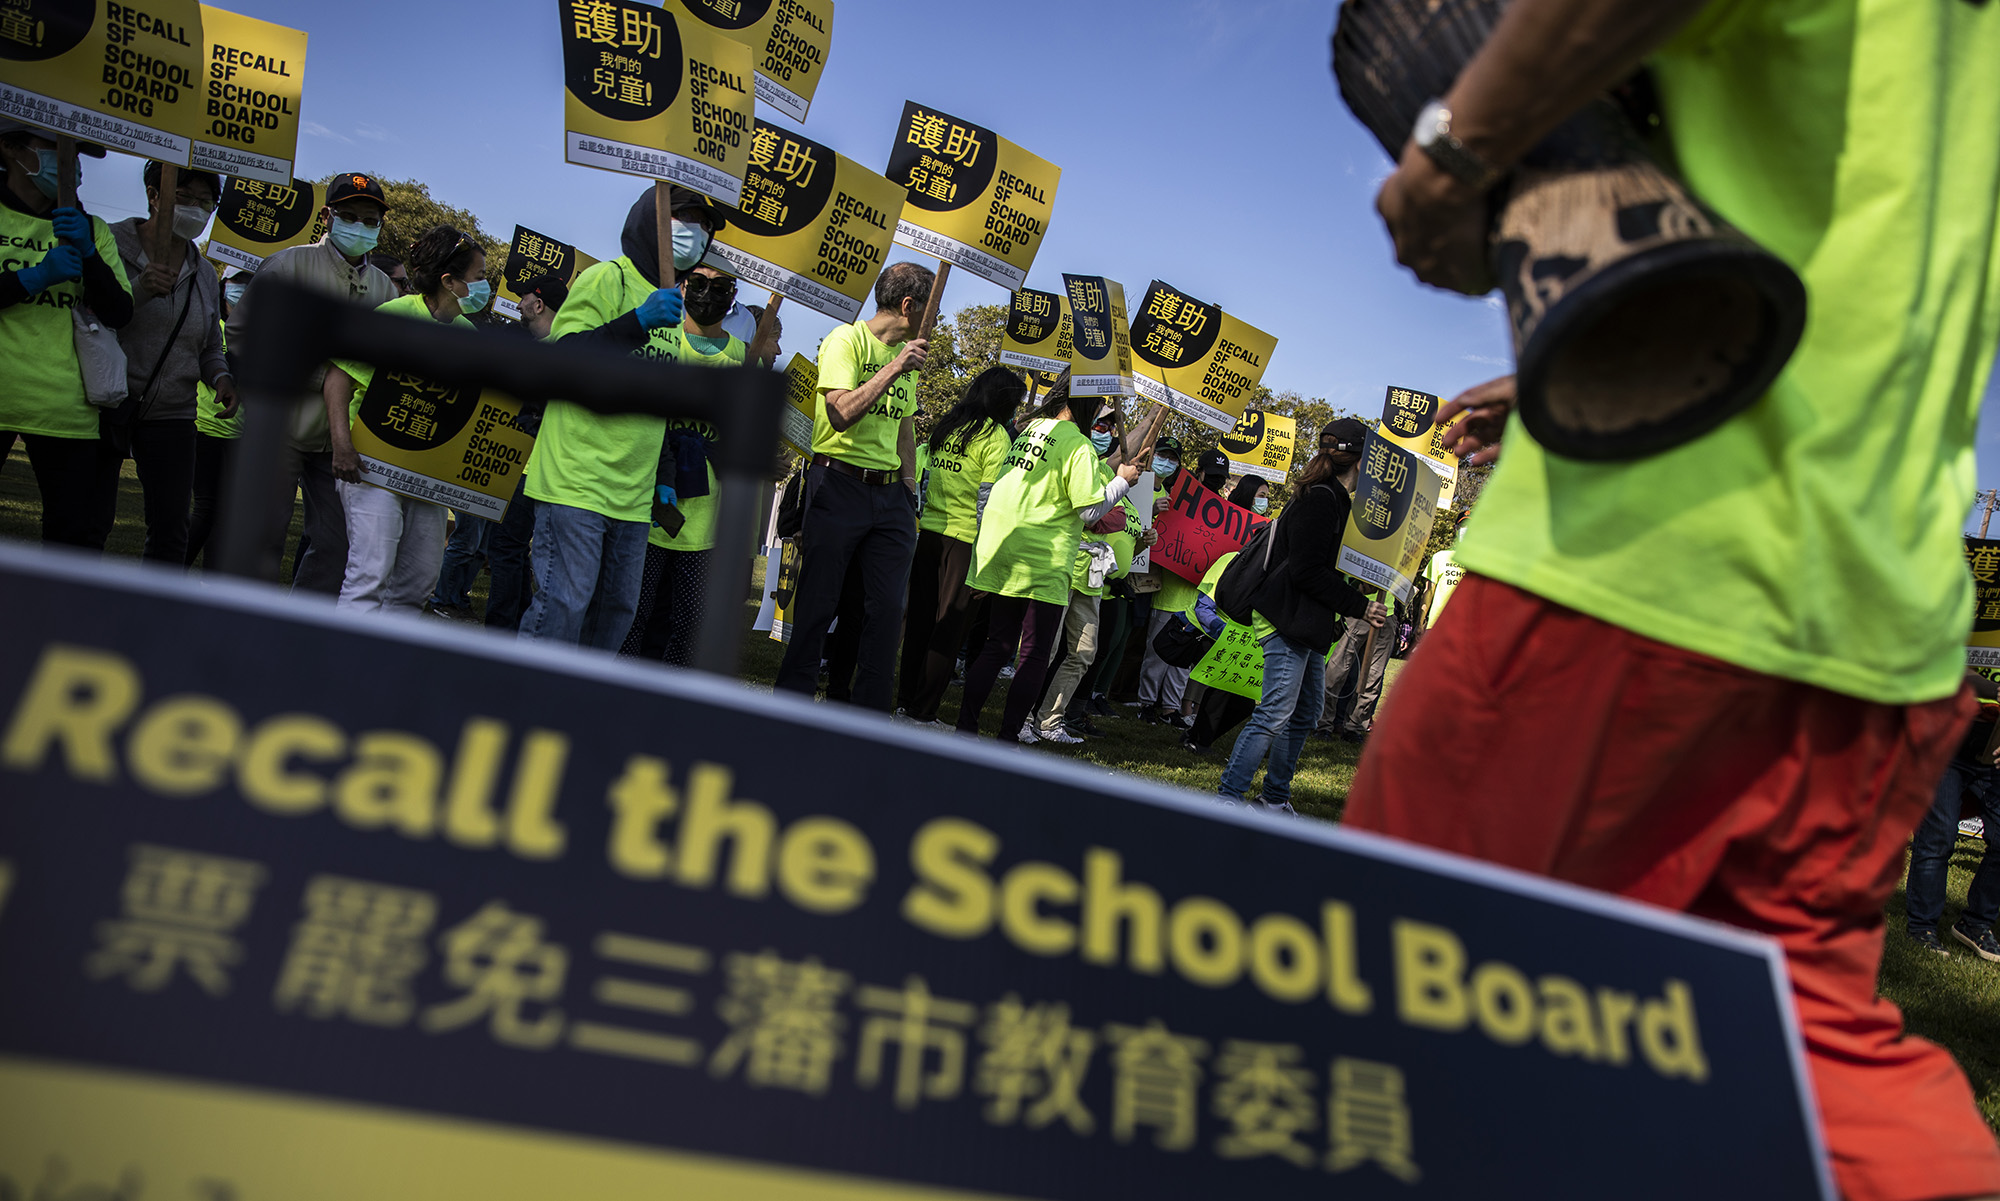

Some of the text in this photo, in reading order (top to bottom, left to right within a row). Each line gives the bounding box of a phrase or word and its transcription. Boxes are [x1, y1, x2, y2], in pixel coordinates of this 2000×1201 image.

[107, 1, 191, 47] RECALL
[573, 0, 662, 59] 護助
[776, 9, 793, 27] SF
[107, 22, 136, 46] SF
[771, 25, 822, 65] SCHOOL
[105, 44, 194, 89] SCHOOL
[210, 62, 237, 81] SF
[212, 44, 291, 77] RECALL
[600, 51, 642, 74] 我們的
[760, 56, 792, 82] .ORG
[765, 41, 811, 74] BOARD
[102, 64, 179, 104] BOARD
[591, 68, 653, 107] 兒童!
[689, 58, 746, 94] RECALL
[690, 78, 709, 99] SF
[100, 88, 153, 117] .ORG
[208, 80, 293, 115] SCHOOL
[206, 102, 279, 131] BOARD
[691, 98, 749, 133] SCHOOL
[205, 121, 255, 144] .ORG
[692, 117, 740, 148] BOARD
[906, 110, 982, 168] 護助
[693, 137, 726, 163] .ORG
[920, 154, 954, 178] 我們的
[747, 172, 785, 198] 我們的
[905, 166, 958, 203] 兒童!
[994, 185, 1013, 203] SF
[998, 169, 1046, 205] RECALL
[246, 199, 276, 217] 我們的
[830, 208, 850, 228] SF
[835, 191, 888, 230] RECALL
[989, 200, 1041, 236] SCHOOL
[234, 208, 280, 237] 兒童!
[984, 215, 1030, 246] BOARD
[517, 231, 565, 270] 護助
[824, 225, 880, 264] SCHOOL
[979, 232, 1012, 255] .ORG
[812, 260, 848, 285] .ORG
[818, 242, 868, 275] BOARD
[1015, 291, 1051, 317] 護助
[1069, 279, 1104, 313] 護助
[1147, 288, 1208, 336] 護助
[1141, 332, 1184, 362] 兒童!
[1155, 323, 1183, 343] 我們的
[1213, 350, 1230, 365] SF
[1218, 338, 1260, 367] RECALL
[790, 368, 815, 391] RECALL
[808, 369, 819, 381] YES
[1202, 373, 1242, 399] BOARD
[1208, 362, 1252, 391] SCHOOL
[400, 393, 437, 416] 我們的
[1197, 386, 1225, 405] .ORG
[1391, 388, 1430, 415] 護助
[381, 405, 438, 441] 兒童!
[474, 420, 495, 436] SF
[1267, 428, 1291, 440] RECALL
[1391, 415, 1418, 434] 兒童!
[469, 435, 522, 465] SCHOOL
[1039, 433, 1057, 446] THE
[1265, 443, 1291, 455] SCHOOL
[1266, 435, 1274, 443] SF
[463, 450, 510, 476] BOARD
[1260, 458, 1277, 468] .ORG
[1263, 450, 1286, 461] BOARD
[1365, 440, 1408, 493] 護助
[1428, 447, 1445, 460] .ORG
[456, 466, 490, 487] .ORG
[1361, 498, 1392, 529] 兒童!
[1150, 519, 1197, 568] Better
[4, 645, 1707, 1082] Recall the School Board
